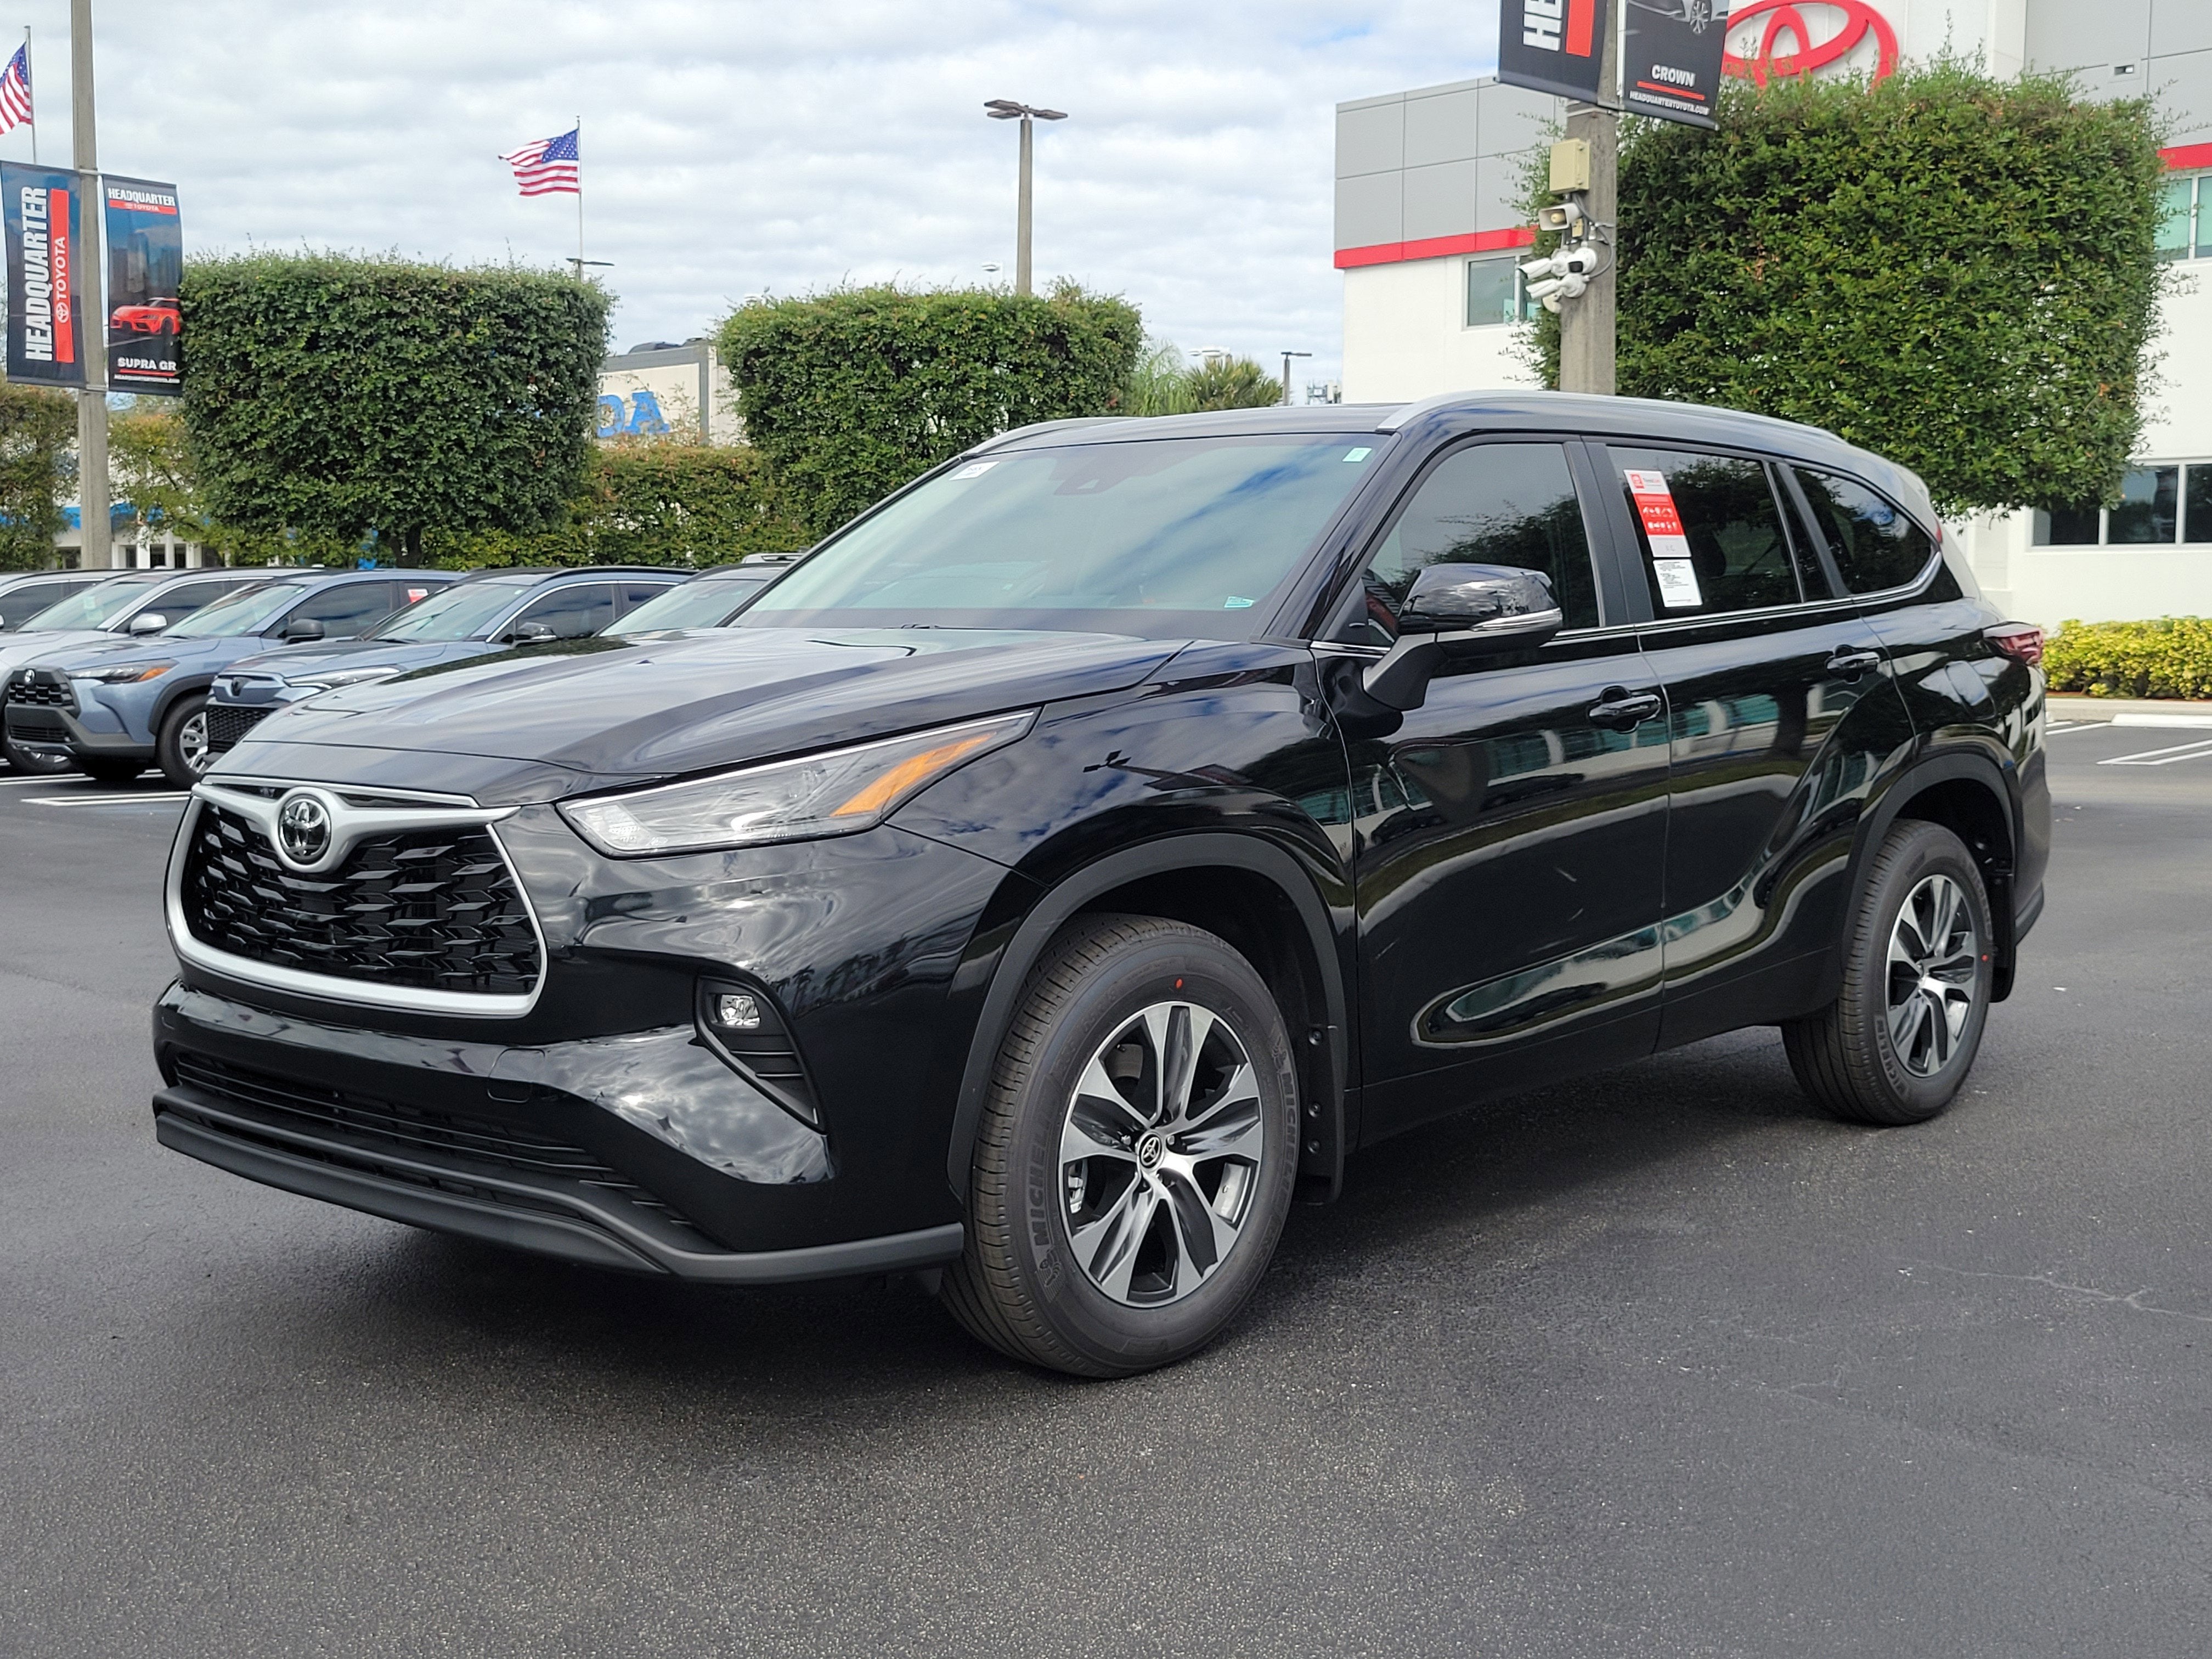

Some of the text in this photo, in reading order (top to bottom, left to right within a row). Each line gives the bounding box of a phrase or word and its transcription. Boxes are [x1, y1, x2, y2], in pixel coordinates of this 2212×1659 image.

[1651, 64, 1696, 87] CROWN
[108, 188, 176, 206] HEADQUARTER
[21, 186, 53, 361] HEADQUARTER
[54, 236, 66, 300] TOYOTA
[117, 357, 177, 371] SUPRA GR
